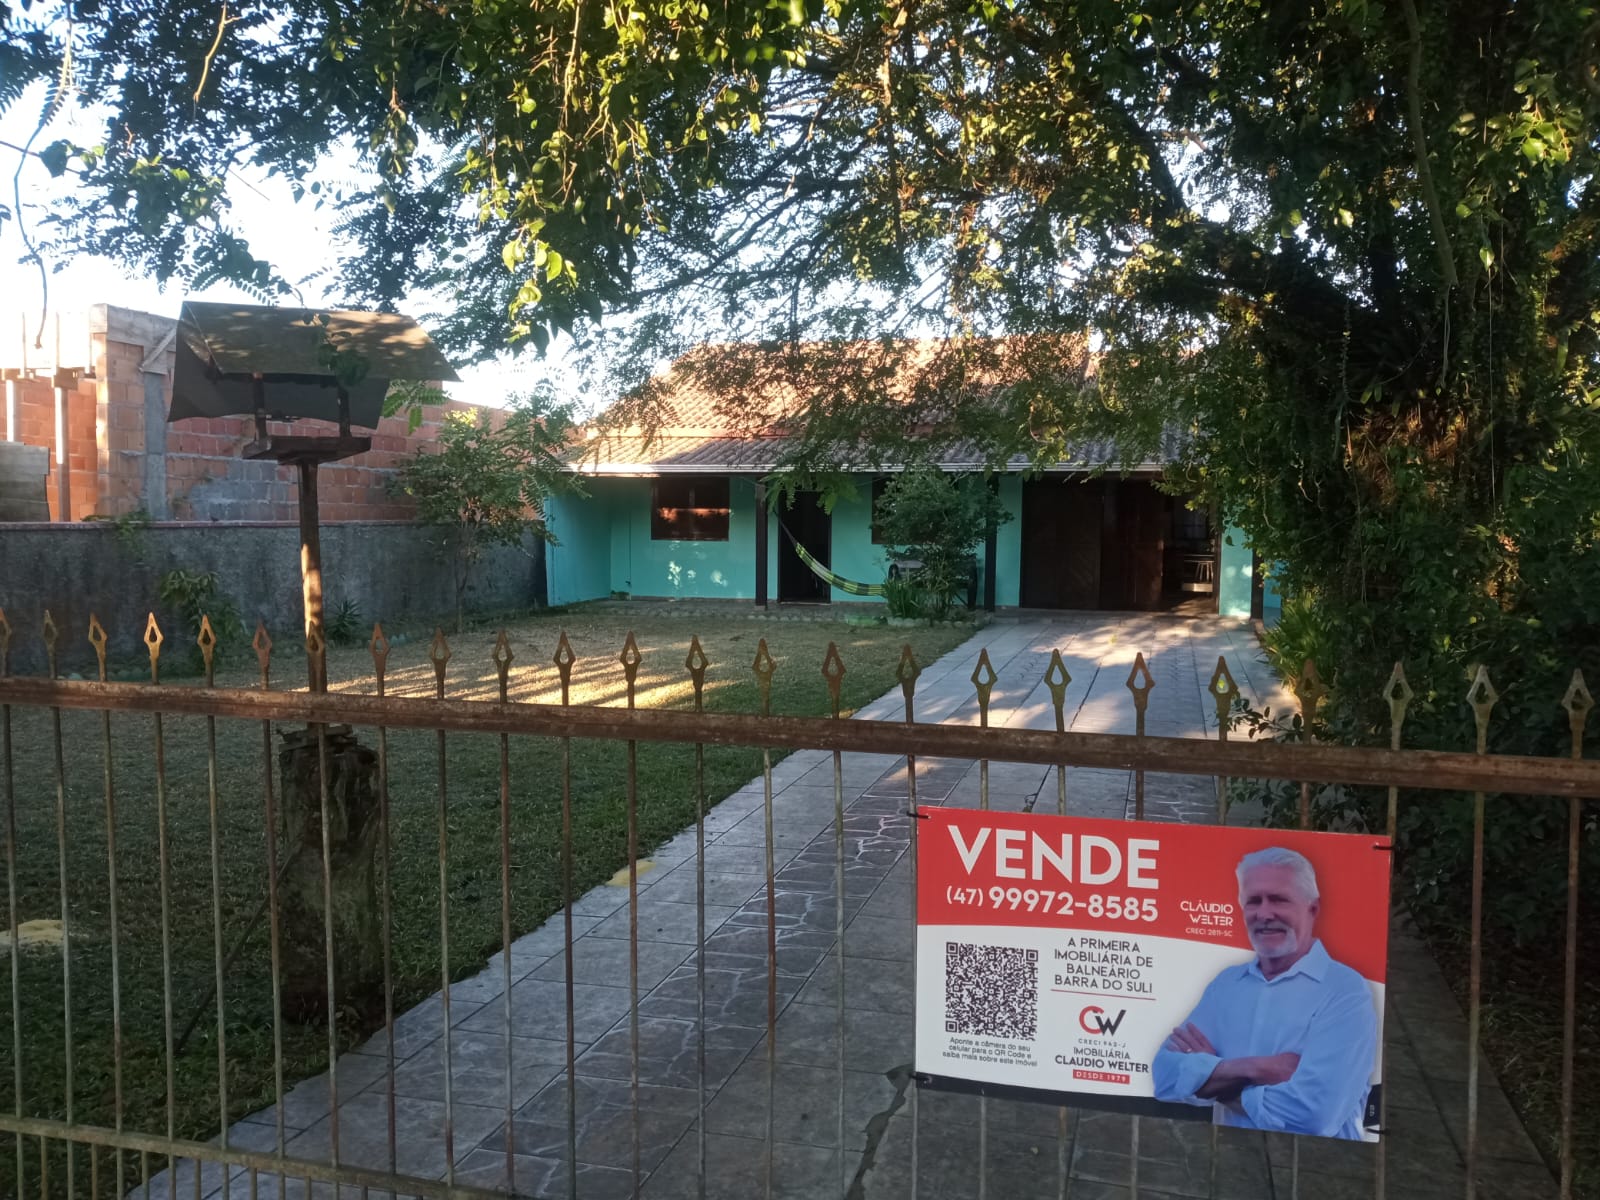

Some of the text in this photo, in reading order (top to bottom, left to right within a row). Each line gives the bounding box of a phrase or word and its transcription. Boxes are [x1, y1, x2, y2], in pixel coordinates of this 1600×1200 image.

[947, 824, 1160, 890] VENDE
[946, 885, 1159, 922] (47) 99972-8585
[1180, 899, 1234, 914] CLÁUDIO
[1189, 913, 1234, 927] WELTER
[1185, 927, 1206, 935] CRECI
[1067, 937, 1141, 953] A PRIMEIRA
[1054, 948, 1153, 967] IMOBILIÁRIA DE
[1066, 963, 1141, 980] BALNEÁRIO
[1054, 974, 1099, 989] BARRA
[1102, 978, 1122, 991] DO
[1078, 1005, 1127, 1037] CW
[950, 1037, 974, 1046] Aponte
[981, 1040, 1006, 1049] câmera
[1078, 1037, 1101, 1046] CRECI
[948, 1044, 970, 1052] celular
[972, 1047, 987, 1055] para
[1008, 1050, 1025, 1058] Code
[961, 1053, 978, 1061] mais
[979, 1055, 998, 1063] sobre
[1073, 1046, 1131, 1060] IMOBILIÁRIA
[1055, 1054, 1150, 1073] CLAUDIO WELTER
[1076, 1070, 1104, 1080] DESDE
